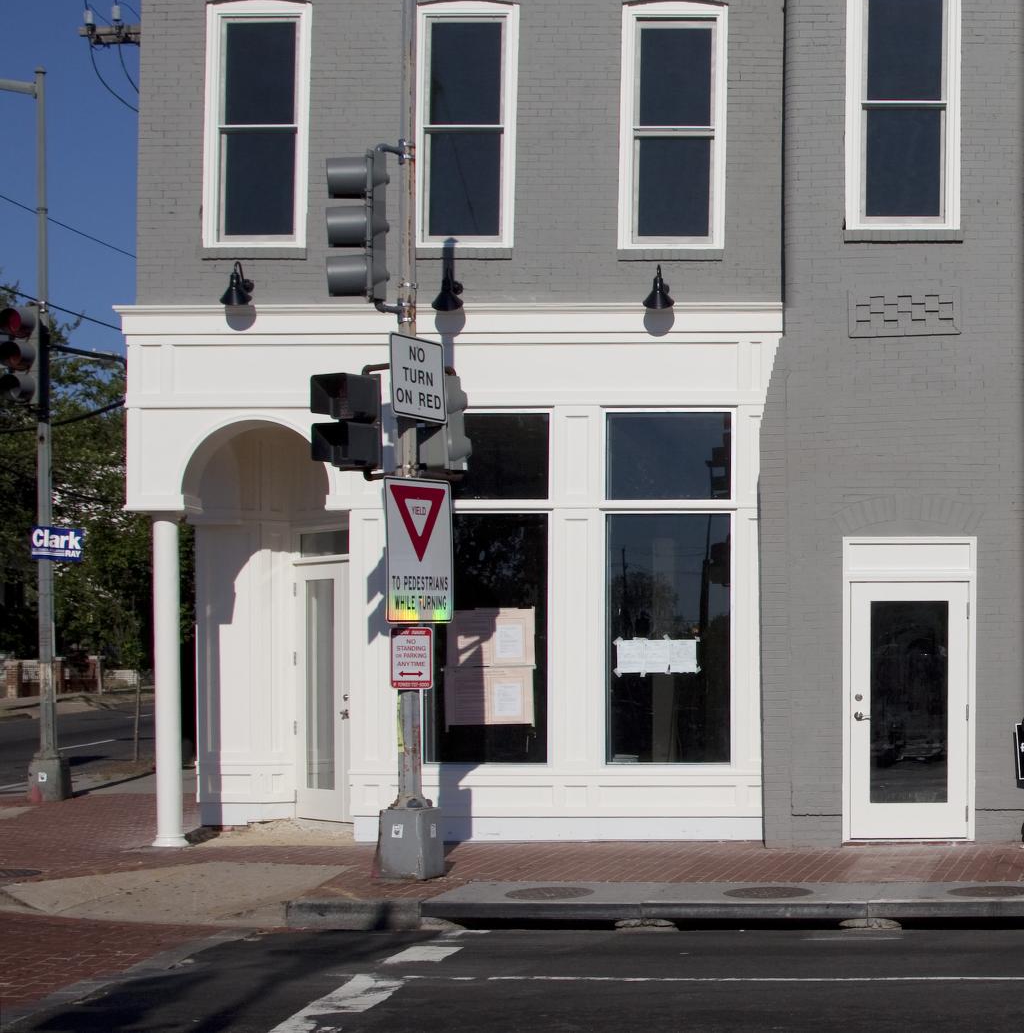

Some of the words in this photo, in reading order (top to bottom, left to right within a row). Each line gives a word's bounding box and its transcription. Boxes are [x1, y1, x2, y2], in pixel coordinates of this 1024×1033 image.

[409, 346, 425, 363] NO
[403, 367, 433, 387] TURN
[396, 387, 413, 405] ON
[418, 391, 442, 410] RED
[412, 506, 426, 516] YIELD
[32, 528, 81, 550] Clark
[65, 549, 81, 558] RAY
[392, 575, 400, 590] TO
[403, 576, 448, 591] PEDESTRIANS
[394, 596, 416, 610] WHILE
[418, 596, 447, 610] TURNING
